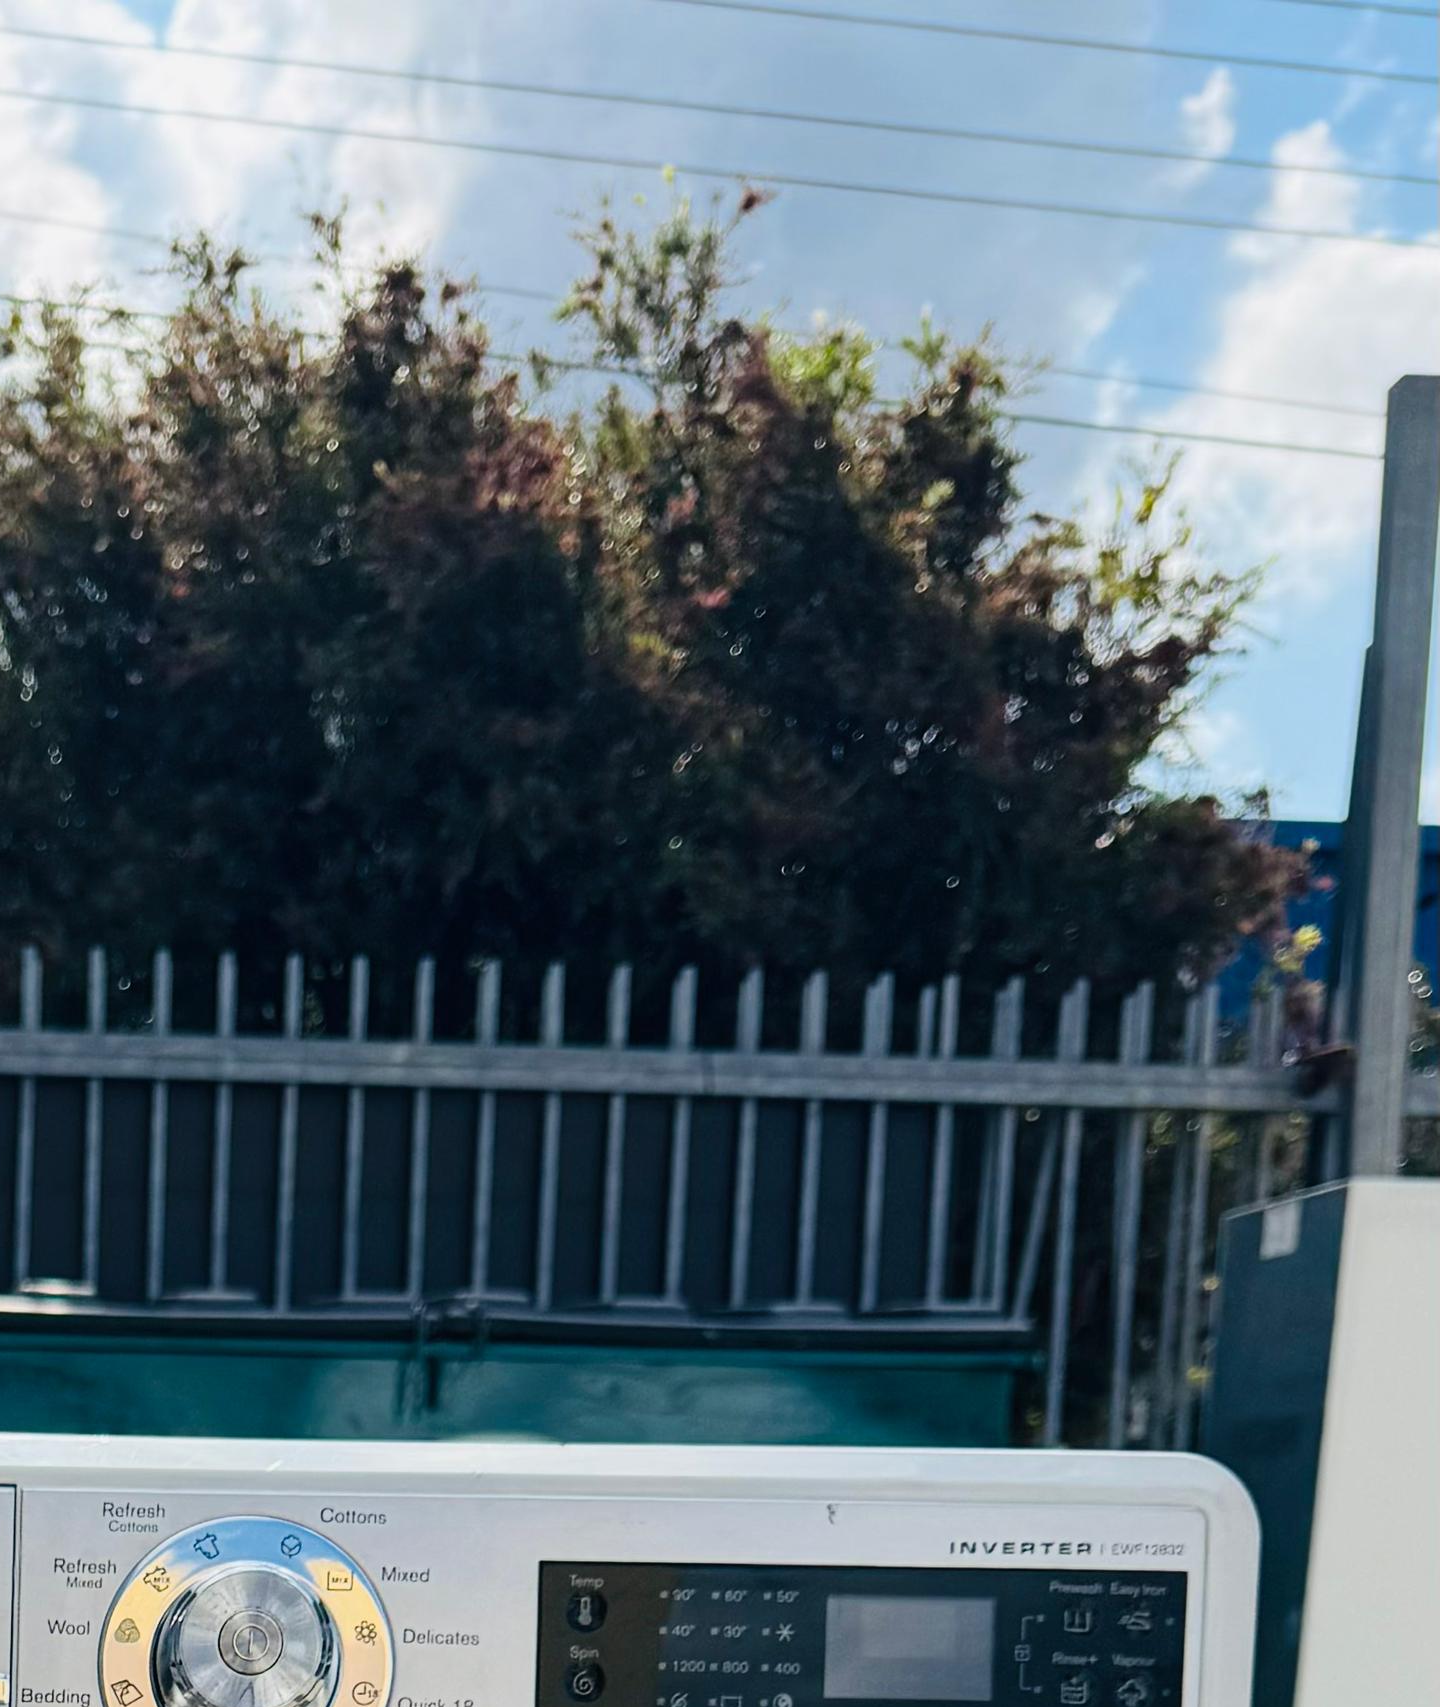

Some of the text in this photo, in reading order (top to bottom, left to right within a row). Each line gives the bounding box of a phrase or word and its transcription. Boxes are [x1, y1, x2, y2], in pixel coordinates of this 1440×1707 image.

[102, 1503, 166, 1520] Refresh
[320, 1508, 387, 1525] Cottons
[108, 1520, 159, 1534] Cottons
[949, 1541, 1092, 1556] INVERTER
[53, 1558, 117, 1576] Refresh
[381, 1566, 430, 1583] Mixed
[66, 1577, 103, 1591] Mixed
[569, 1574, 604, 1591] Temp
[47, 1620, 91, 1637] Wool
[403, 1629, 480, 1646] Delicates
[570, 1645, 600, 1662] Spin
[673, 1660, 801, 1675] 1200 800 400
